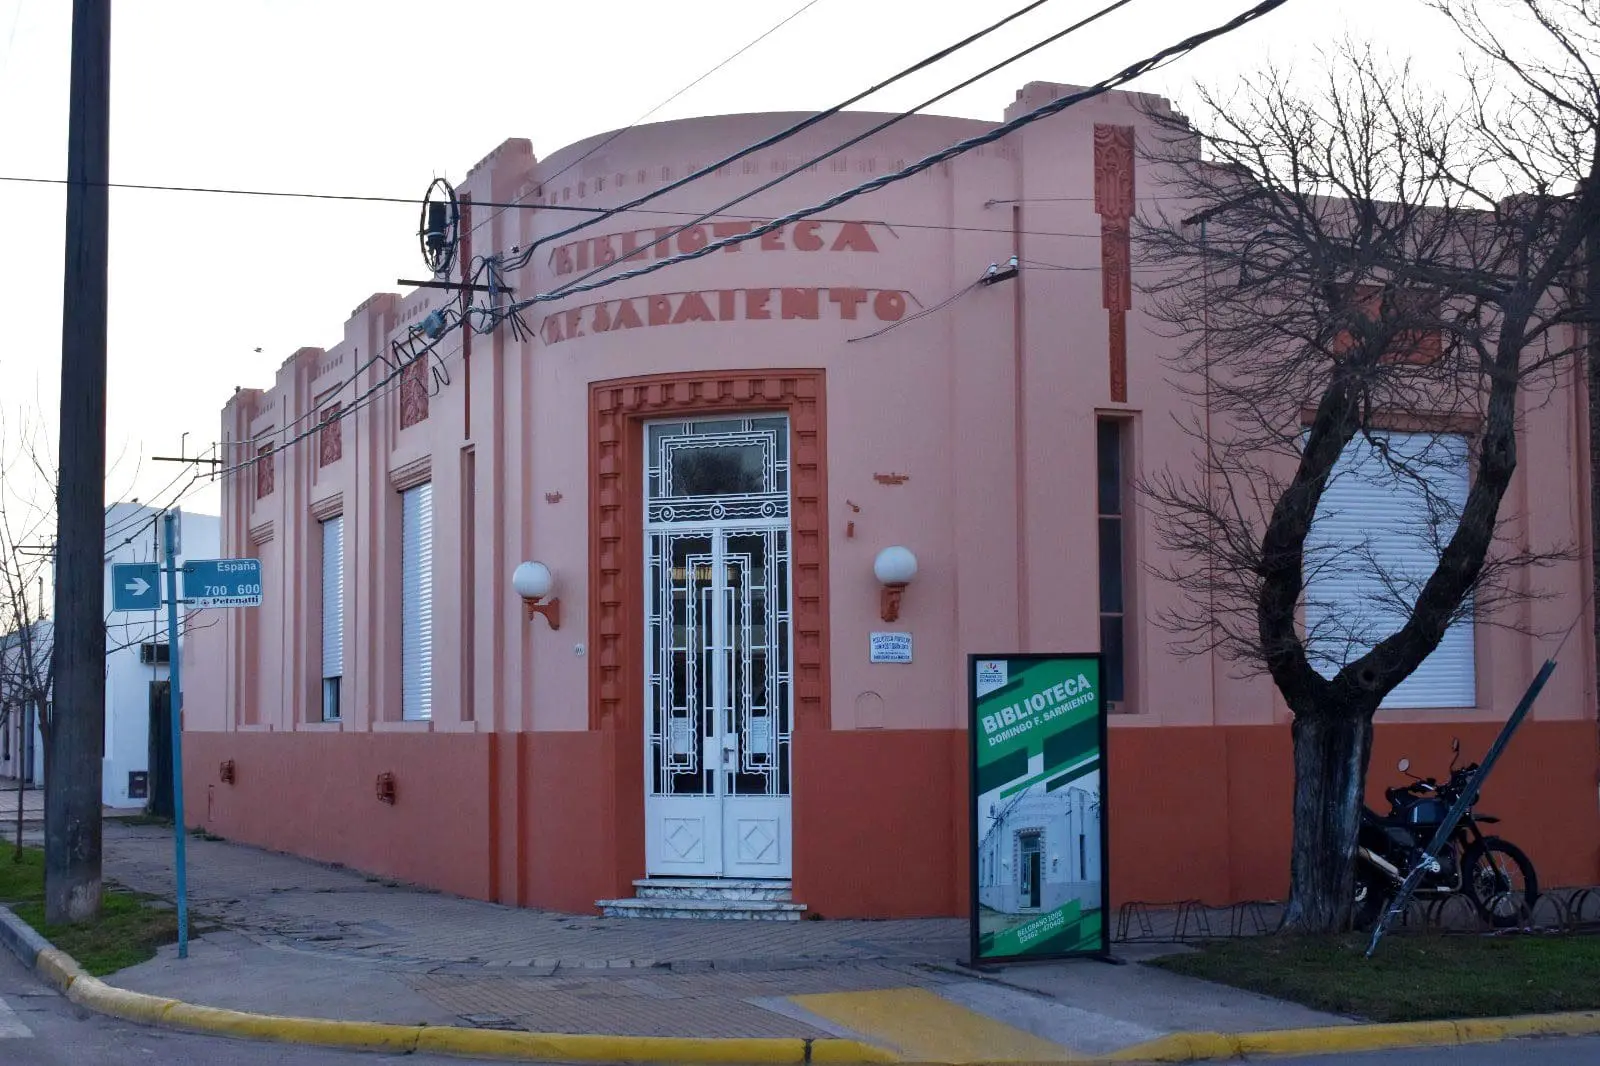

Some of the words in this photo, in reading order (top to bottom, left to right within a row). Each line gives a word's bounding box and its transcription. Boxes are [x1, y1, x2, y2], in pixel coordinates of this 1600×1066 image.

[556, 220, 879, 276] BIBLIOTECA
[592, 288, 906, 333] SARMIENTO
[204, 586, 227, 596] 700
[237, 584, 260, 595] 600
[217, 562, 257, 573] España
[981, 673, 1092, 735] BIBLIOTECA
[988, 720, 1033, 747] DOMINGO
[1034, 716, 1043, 726] F.
[1043, 691, 1095, 721] SARMIENTO
